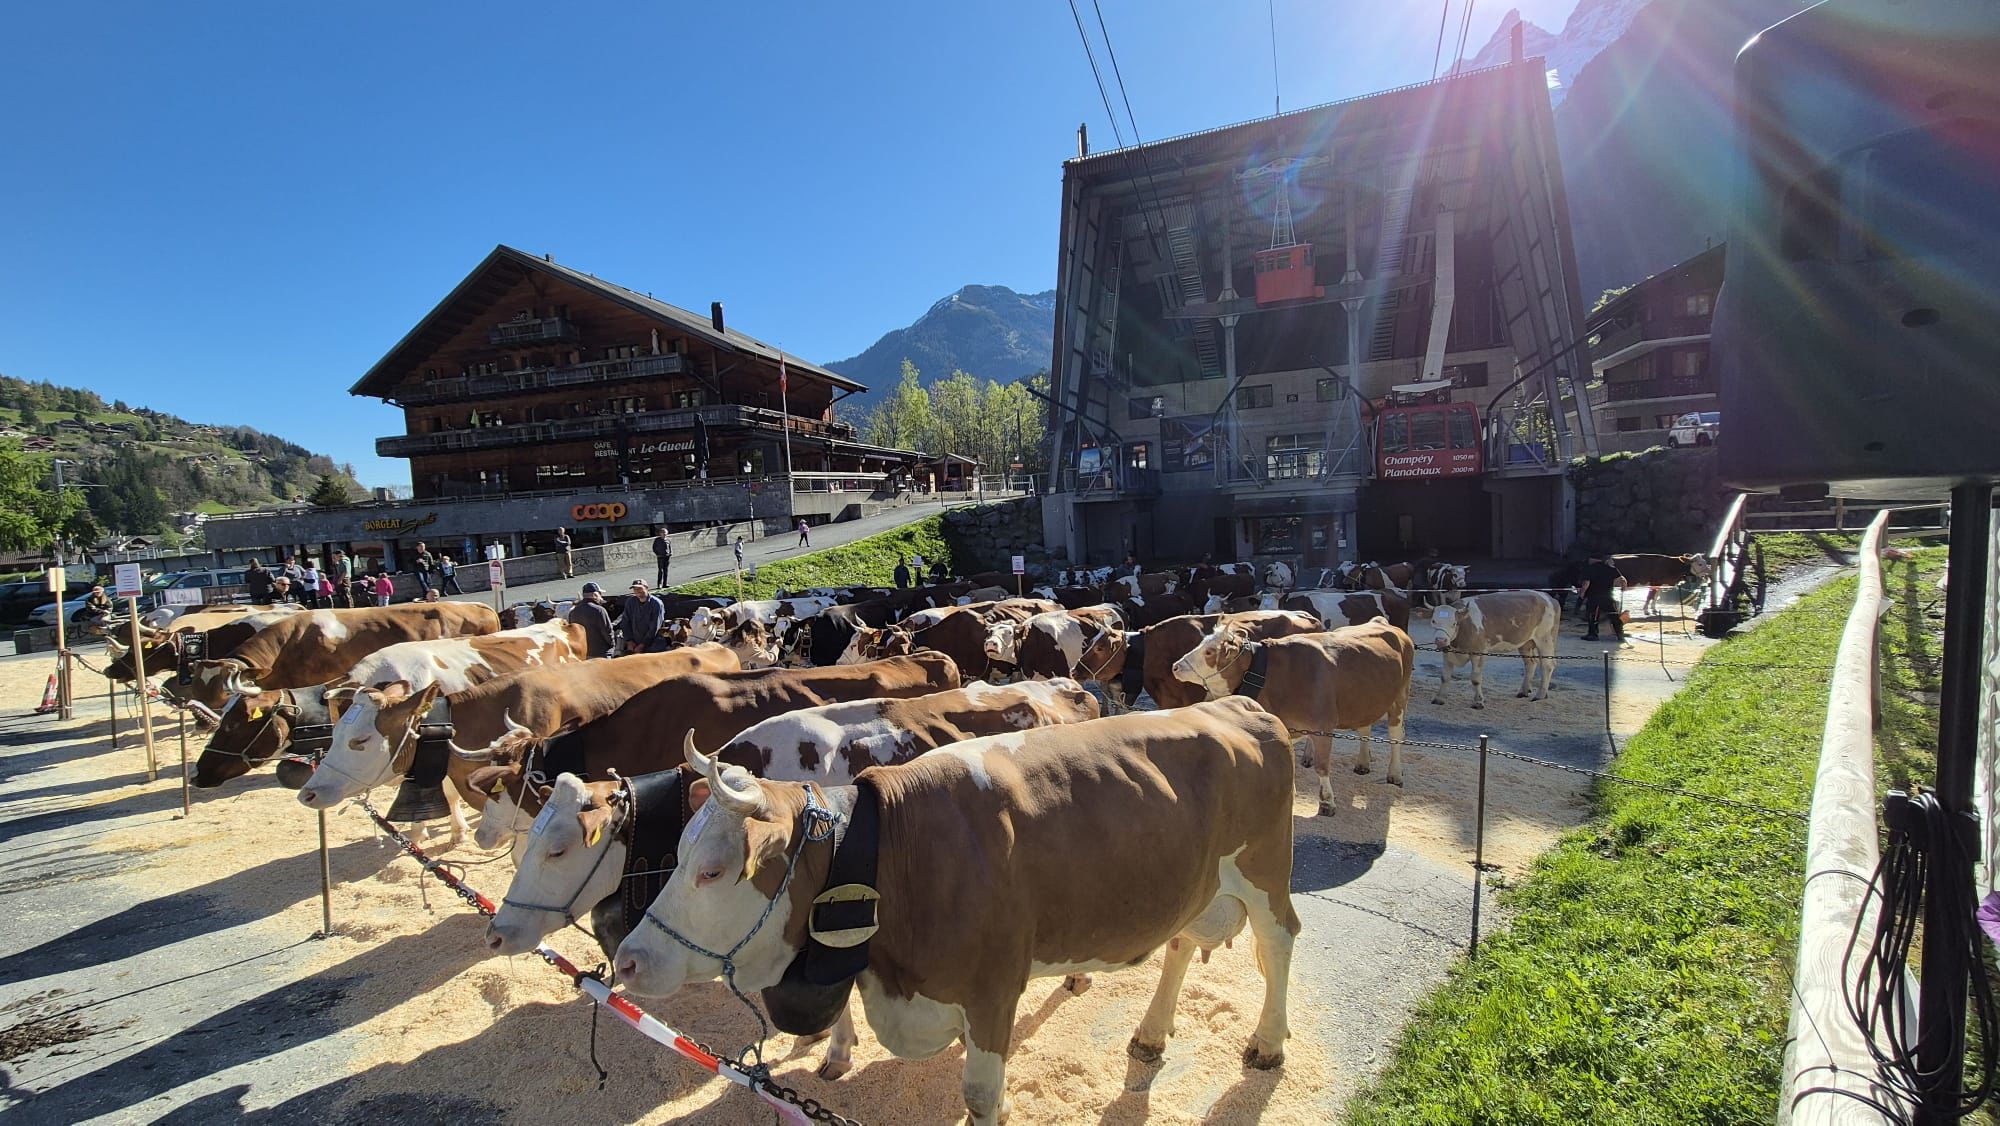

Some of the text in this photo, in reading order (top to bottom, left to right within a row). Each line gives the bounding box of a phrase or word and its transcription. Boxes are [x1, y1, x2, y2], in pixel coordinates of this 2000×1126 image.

[1384, 454, 1434, 466] Champéry
[1384, 466, 1442, 477] Planachaux
[572, 502, 627, 522] coop
[364, 519, 402, 531] BORGEAT
